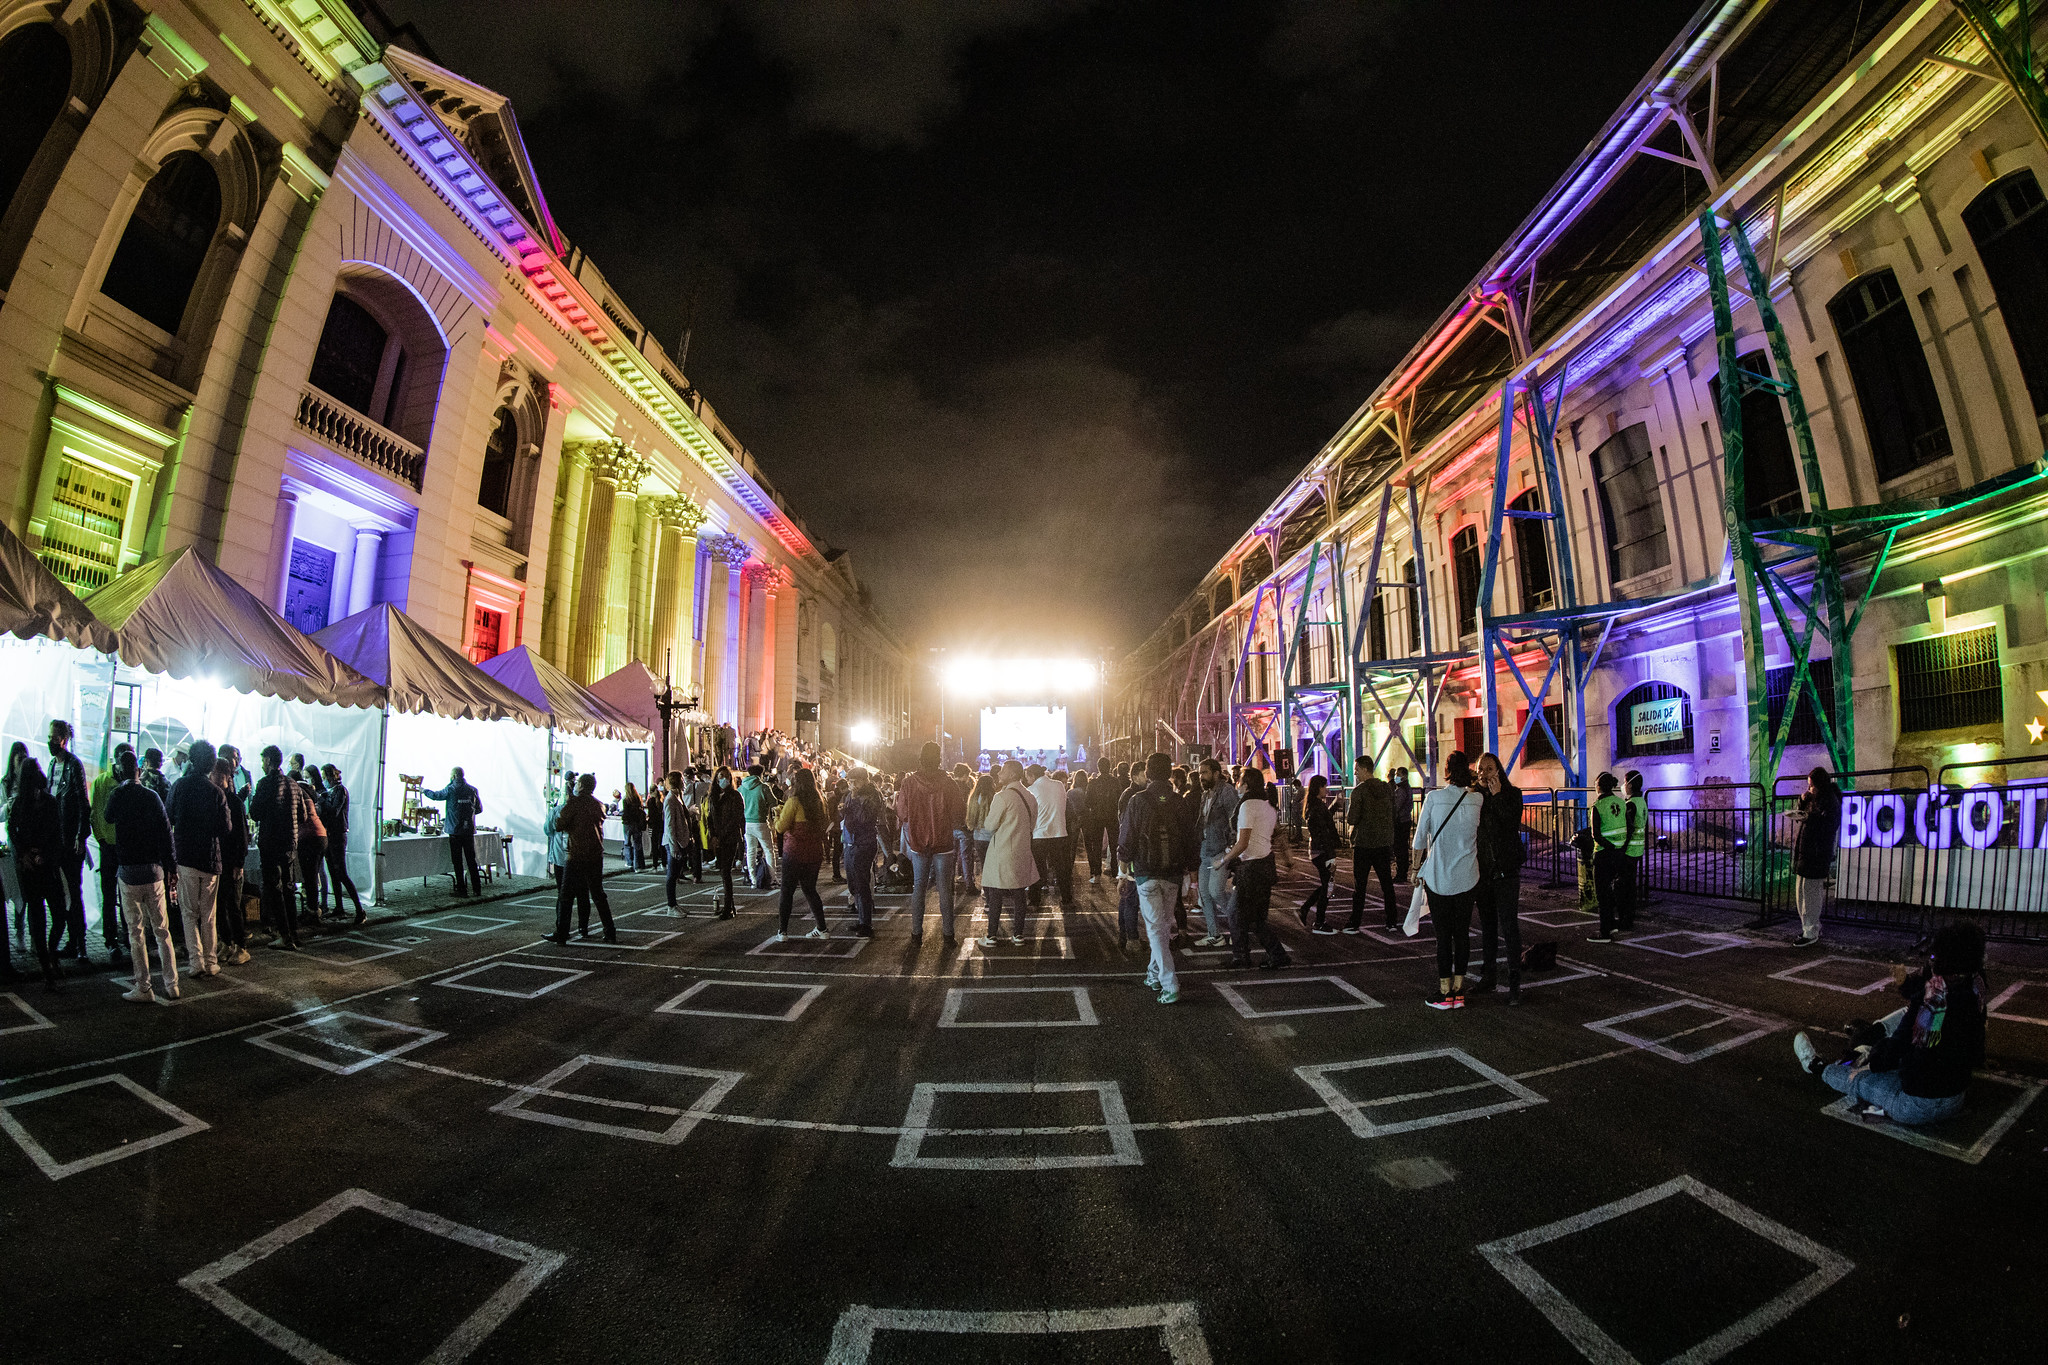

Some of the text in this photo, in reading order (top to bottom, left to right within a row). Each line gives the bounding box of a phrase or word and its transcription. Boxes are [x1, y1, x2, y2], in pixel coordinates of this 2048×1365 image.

[1638, 707, 1674, 722] SALIDA DE
[1634, 720, 1679, 736] EMERGENCIA
[1840, 777, 2048, 849] BOGOT
